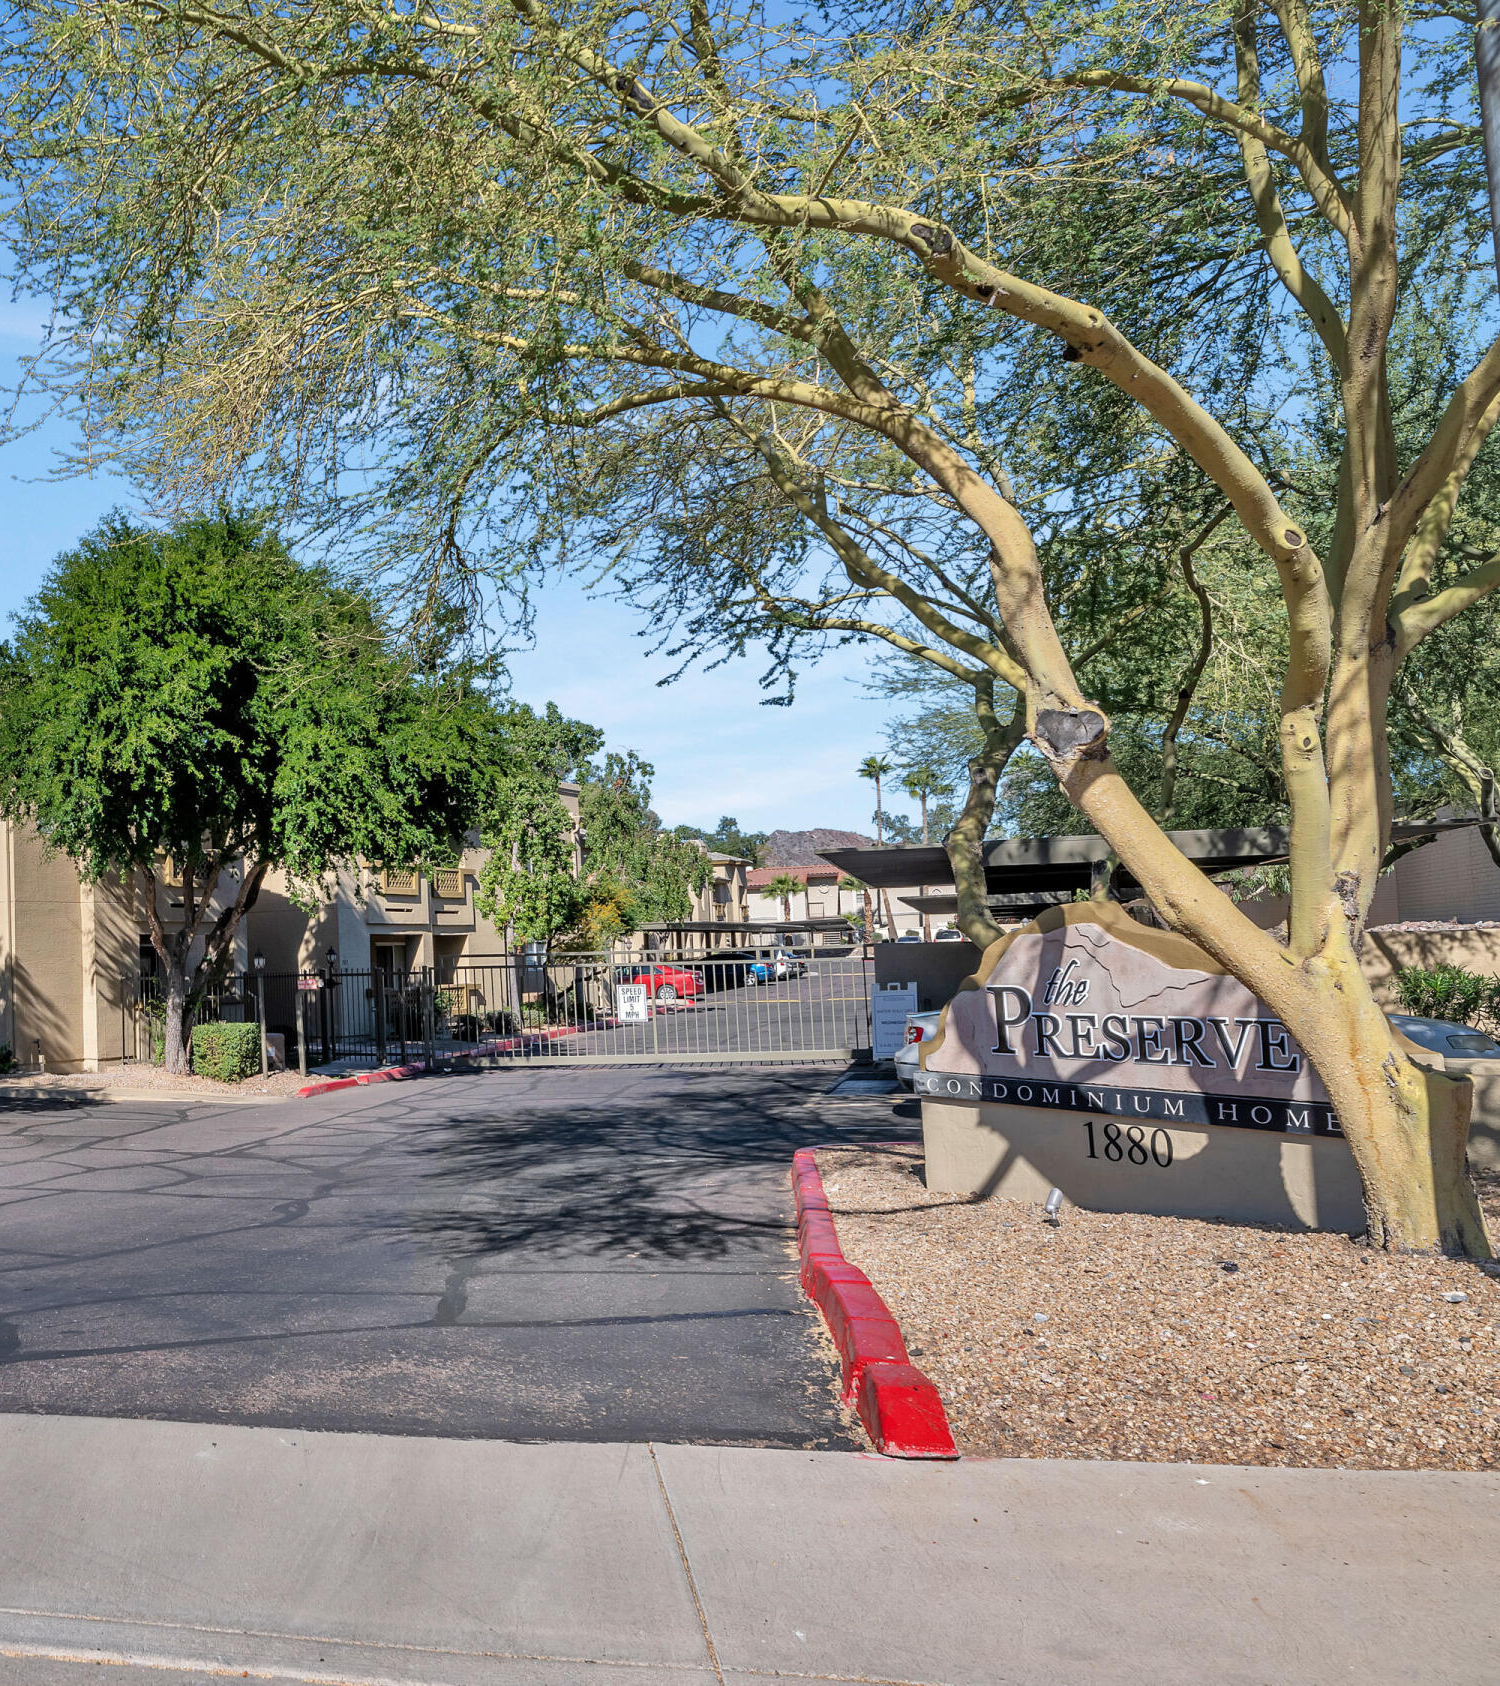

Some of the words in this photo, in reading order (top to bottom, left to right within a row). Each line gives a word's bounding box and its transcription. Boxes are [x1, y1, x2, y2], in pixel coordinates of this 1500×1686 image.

[621, 987, 642, 995] SPEED
[623, 995, 640, 1003] LIMIT
[1043, 958, 1090, 1006] the
[625, 1011, 640, 1019] MPH
[985, 985, 1300, 1074] PRESERVE
[926, 1078, 1185, 1116] CONDOMINIUM
[1217, 1102, 1342, 1132] HOME
[1083, 1121, 1174, 1168] 1880
